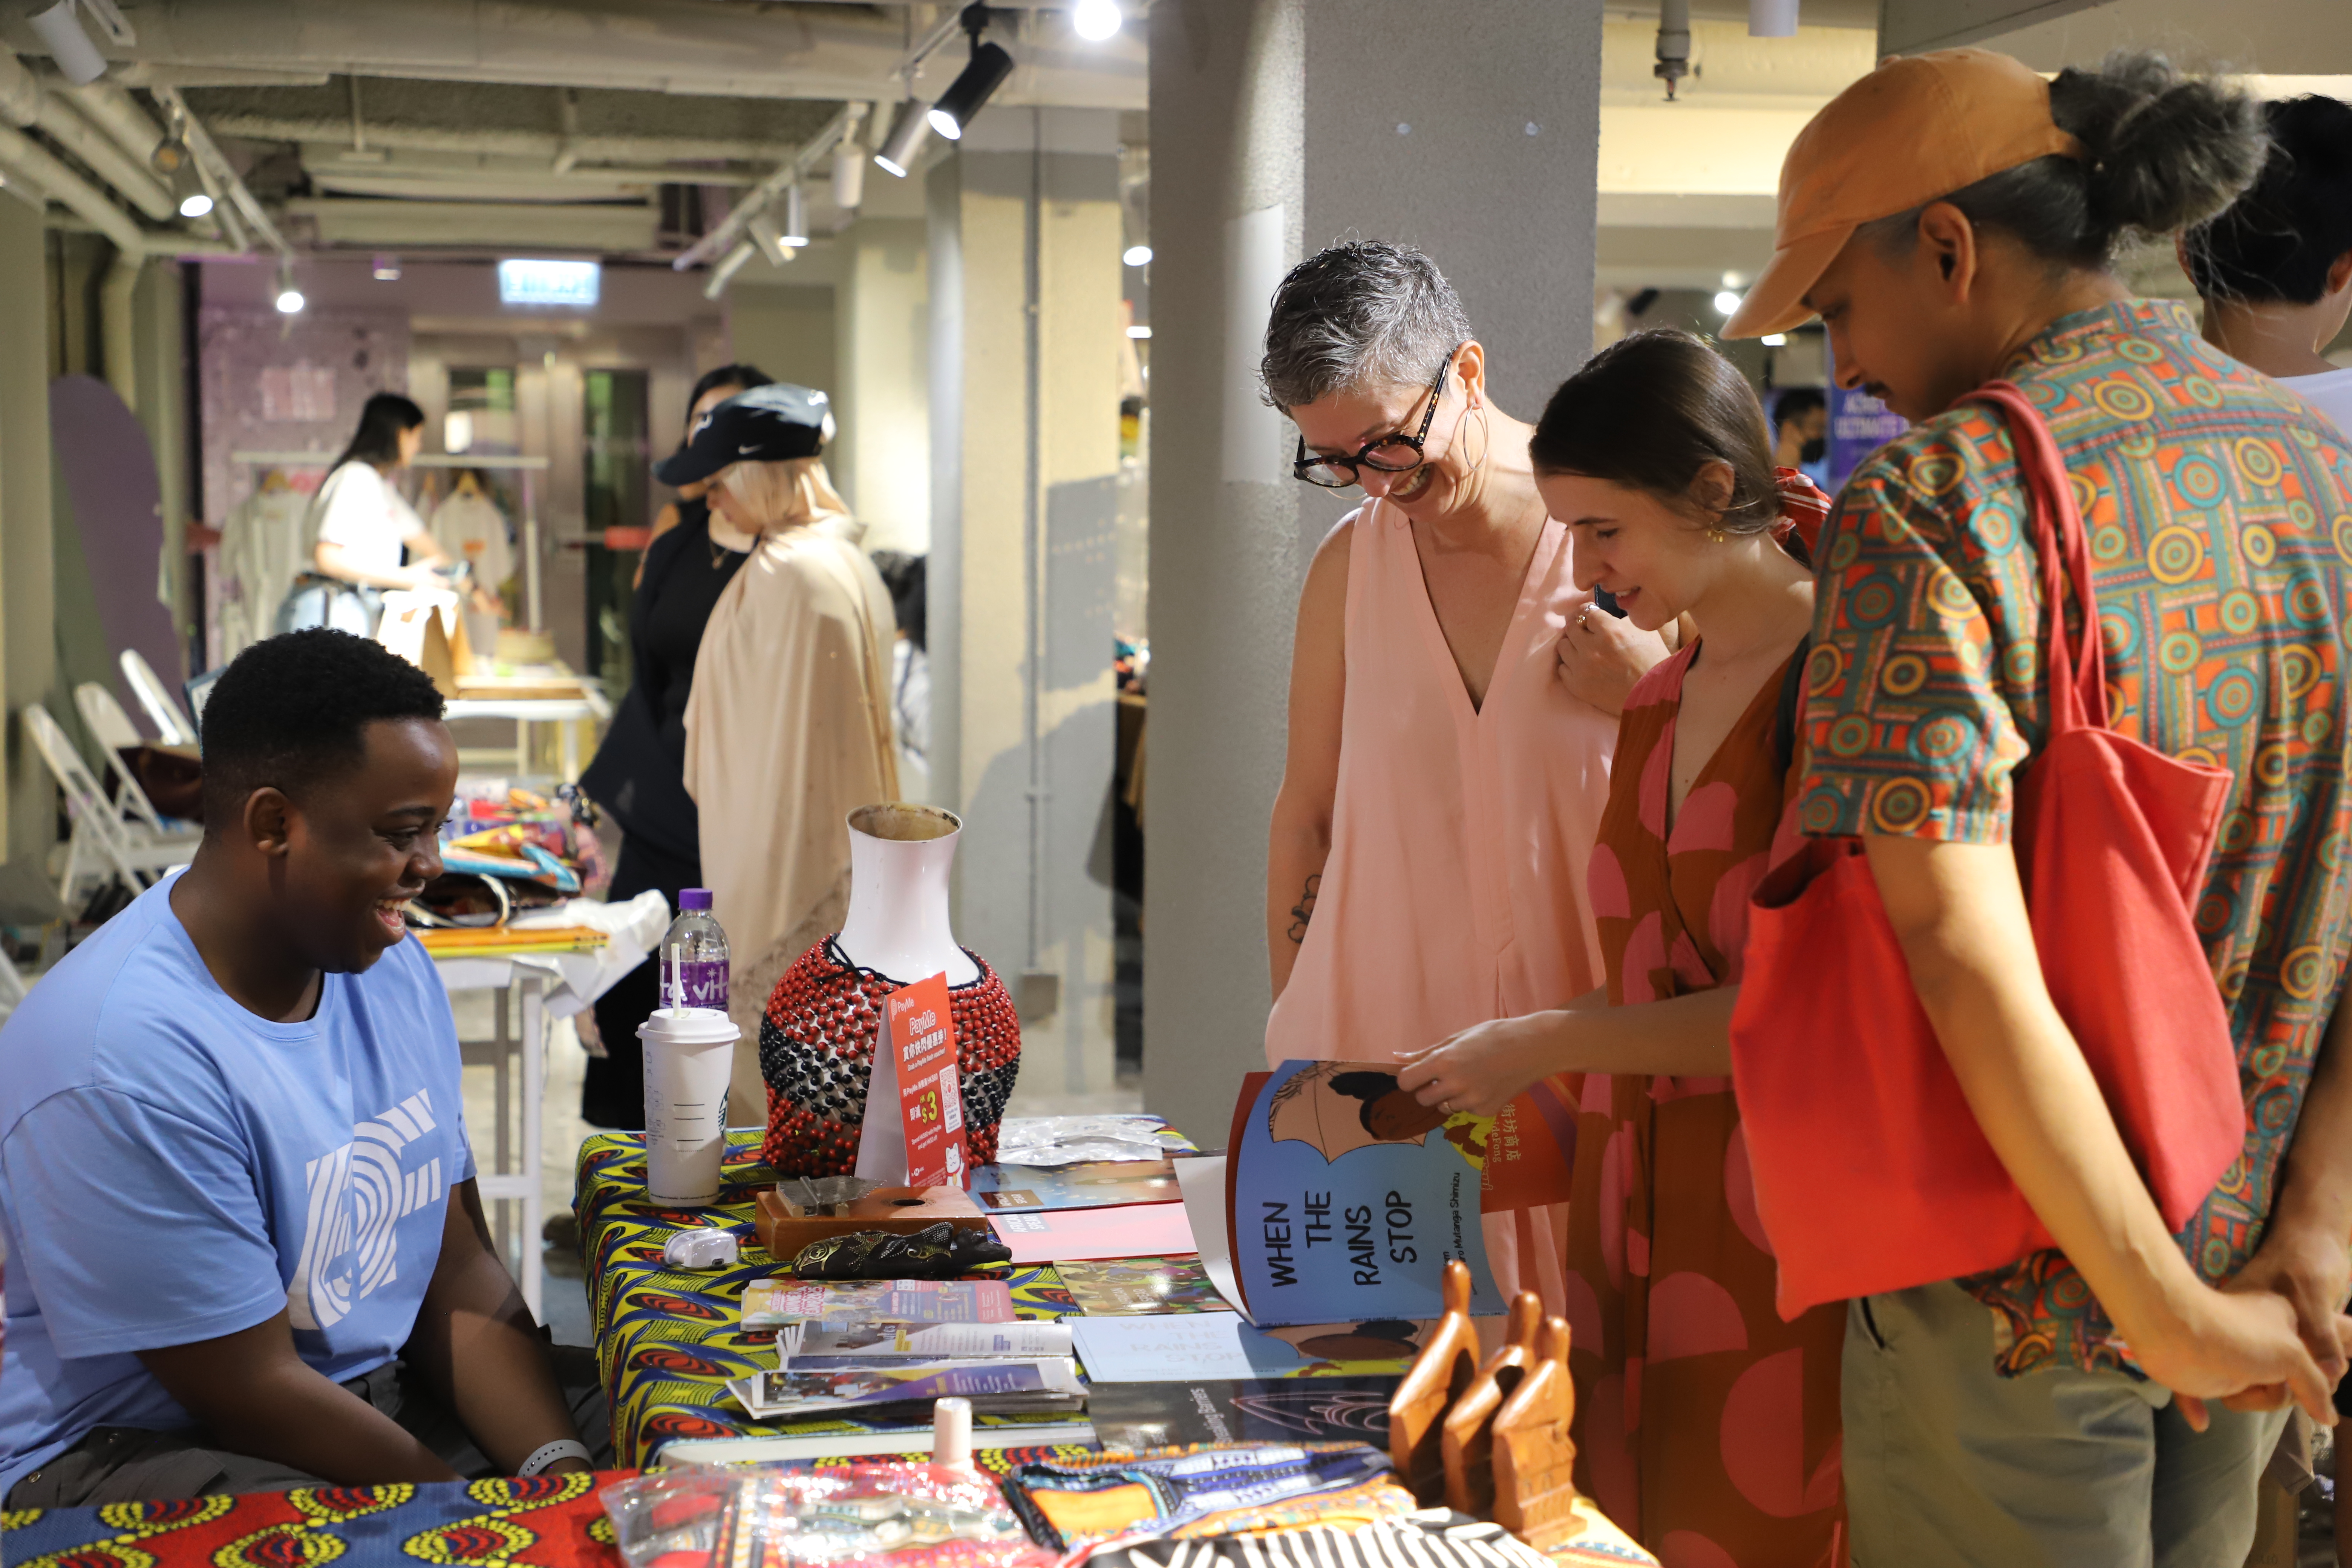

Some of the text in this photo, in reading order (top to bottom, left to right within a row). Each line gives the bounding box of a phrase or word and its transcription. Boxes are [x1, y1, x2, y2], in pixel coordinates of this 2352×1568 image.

[897, 997, 914, 1012] PayMe
[909, 1010, 936, 1036] PayMe
[917, 1057, 927, 1066] PayMe
[907, 1084, 918, 1095] PayMe
[1491, 1121, 1502, 1163] ideFong
[1501, 1103, 1522, 1161] 街坊商店
[1011, 1194, 1028, 1204] SPEAR
[1450, 1172, 1460, 1208] Shimizu
[1003, 1214, 1028, 1232] AFRICAN
[1023, 1215, 1045, 1230] SPEAR
[1305, 1190, 1332, 1248] THE
[1386, 1190, 1417, 1263] STOP
[1453, 1210, 1463, 1248] Mutanga
[1262, 1202, 1298, 1287] WHEN
[1345, 1205, 1382, 1285] RAINS
[784, 1291, 803, 1312] SUMMER
[803, 1300, 823, 1315] CAMP
